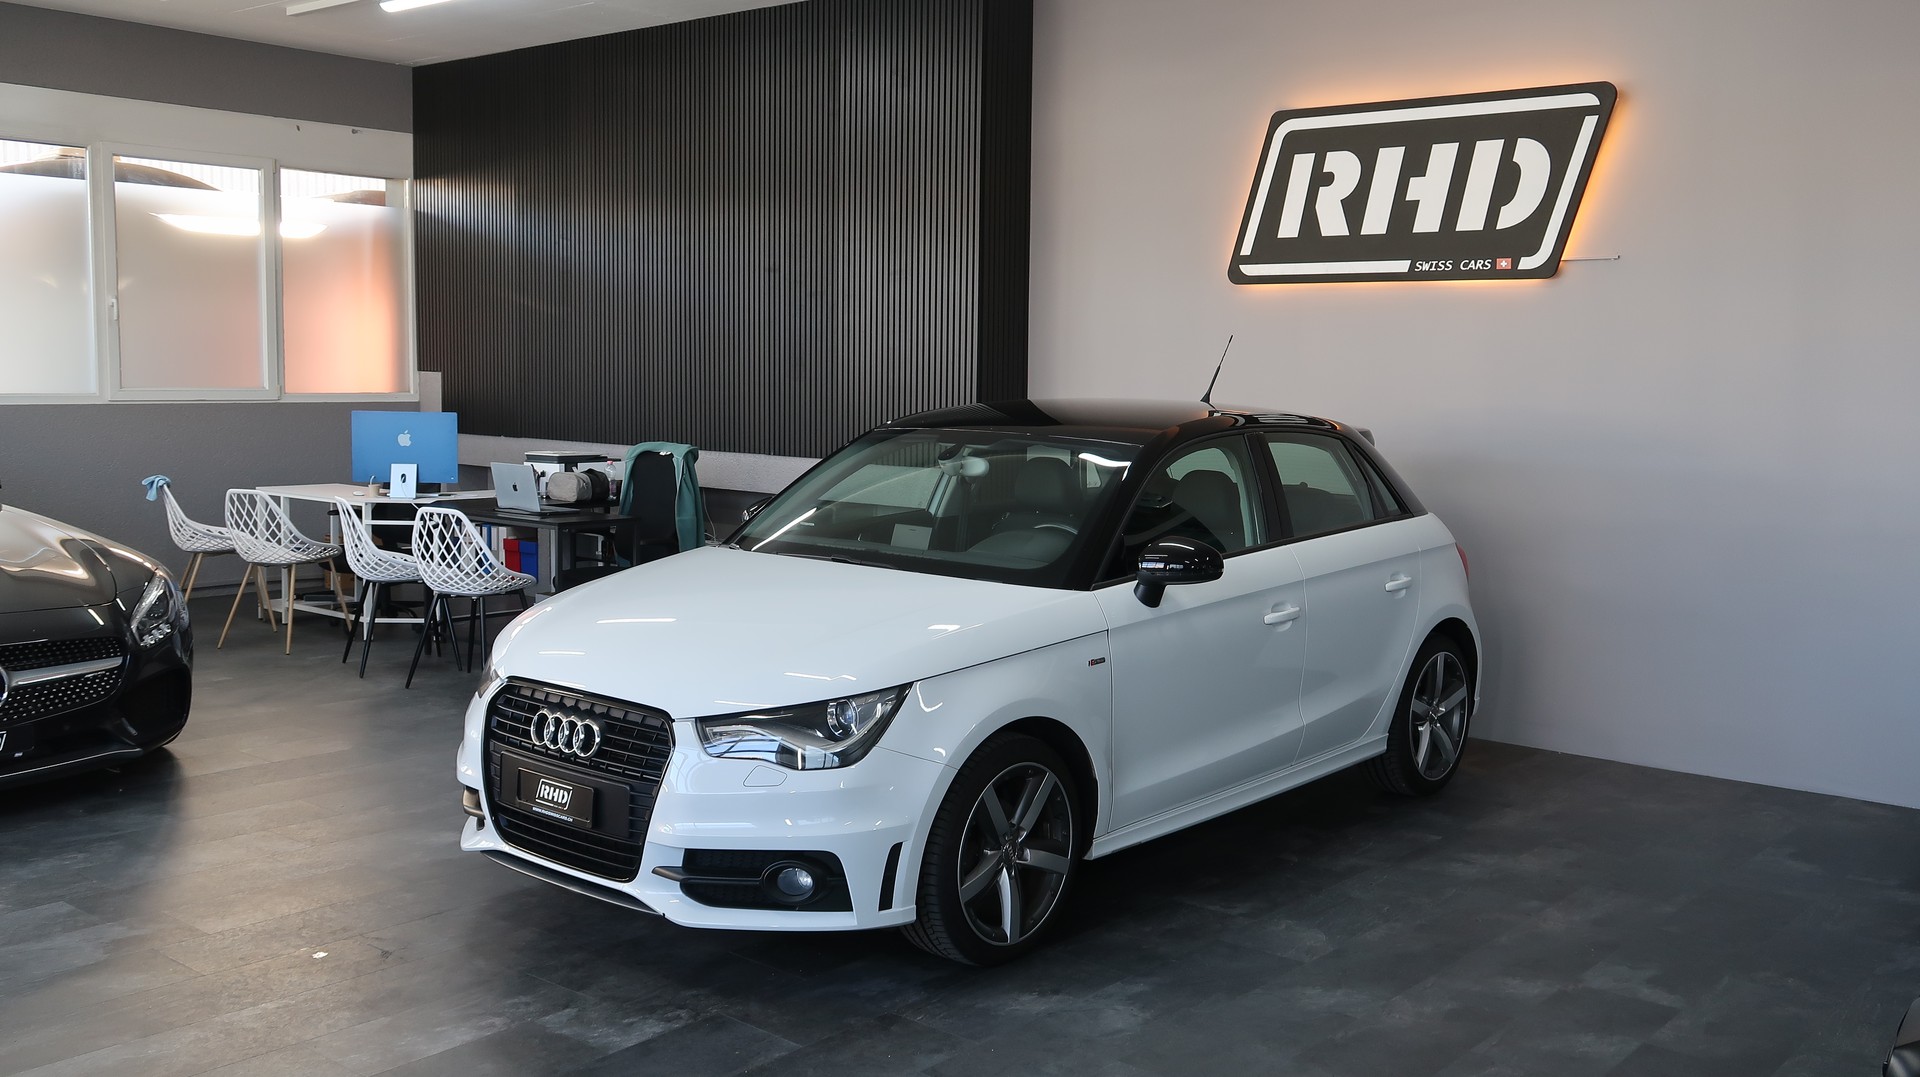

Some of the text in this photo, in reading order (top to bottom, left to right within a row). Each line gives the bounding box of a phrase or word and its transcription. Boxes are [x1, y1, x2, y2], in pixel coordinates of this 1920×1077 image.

[1277, 137, 1551, 238] RHD
[1414, 259, 1492, 271] SWISS CARS
[540, 784, 569, 804] RHD
